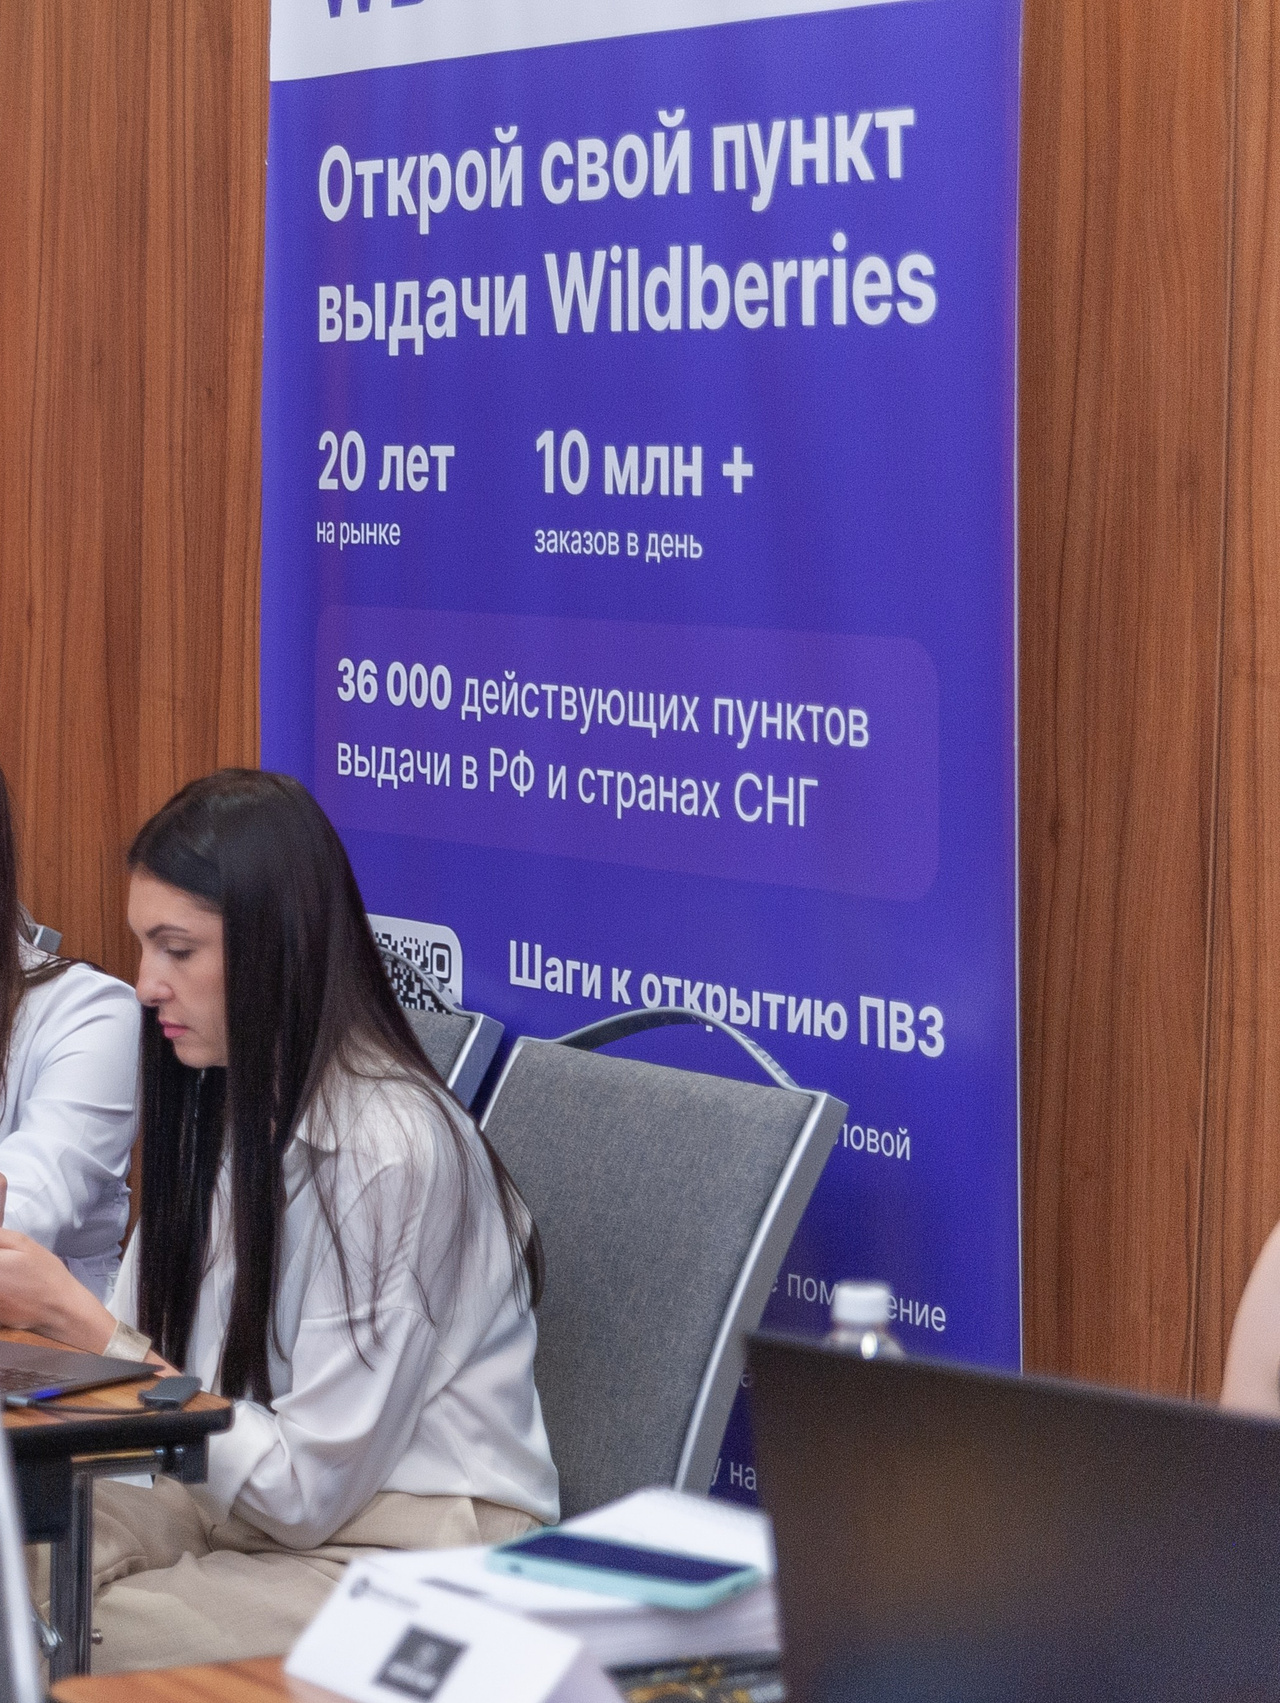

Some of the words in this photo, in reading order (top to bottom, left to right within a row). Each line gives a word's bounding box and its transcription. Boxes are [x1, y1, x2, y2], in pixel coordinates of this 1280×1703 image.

[318, 125, 523, 235] Открой
[540, 107, 691, 205] свой
[712, 107, 916, 212] пункт
[318, 274, 527, 357] выдачи
[544, 231, 938, 334] Wildberries
[318, 430, 367, 492] 20
[378, 444, 456, 492] лет
[535, 429, 590, 496] 10
[604, 445, 703, 497] млн
[316, 521, 335, 544] на
[339, 521, 401, 551] рынке
[534, 529, 620, 556] заказов
[626, 532, 640, 557] в
[644, 532, 703, 564] день
[337, 657, 379, 704] 36
[386, 661, 452, 711] 000
[461, 669, 700, 739] действующих
[713, 697, 870, 750] пунктов
[337, 742, 451, 790] выдачи
[462, 754, 478, 790] в
[489, 747, 535, 798] РФ
[548, 763, 567, 800] и
[577, 767, 721, 820] странах
[734, 772, 819, 827] СНГ
[509, 939, 602, 1000] Шаги
[611, 967, 632, 1005] к
[640, 972, 848, 1041] открытию
[859, 995, 945, 1058] ПВЗ
[787, 1272, 946, 1333] помение
